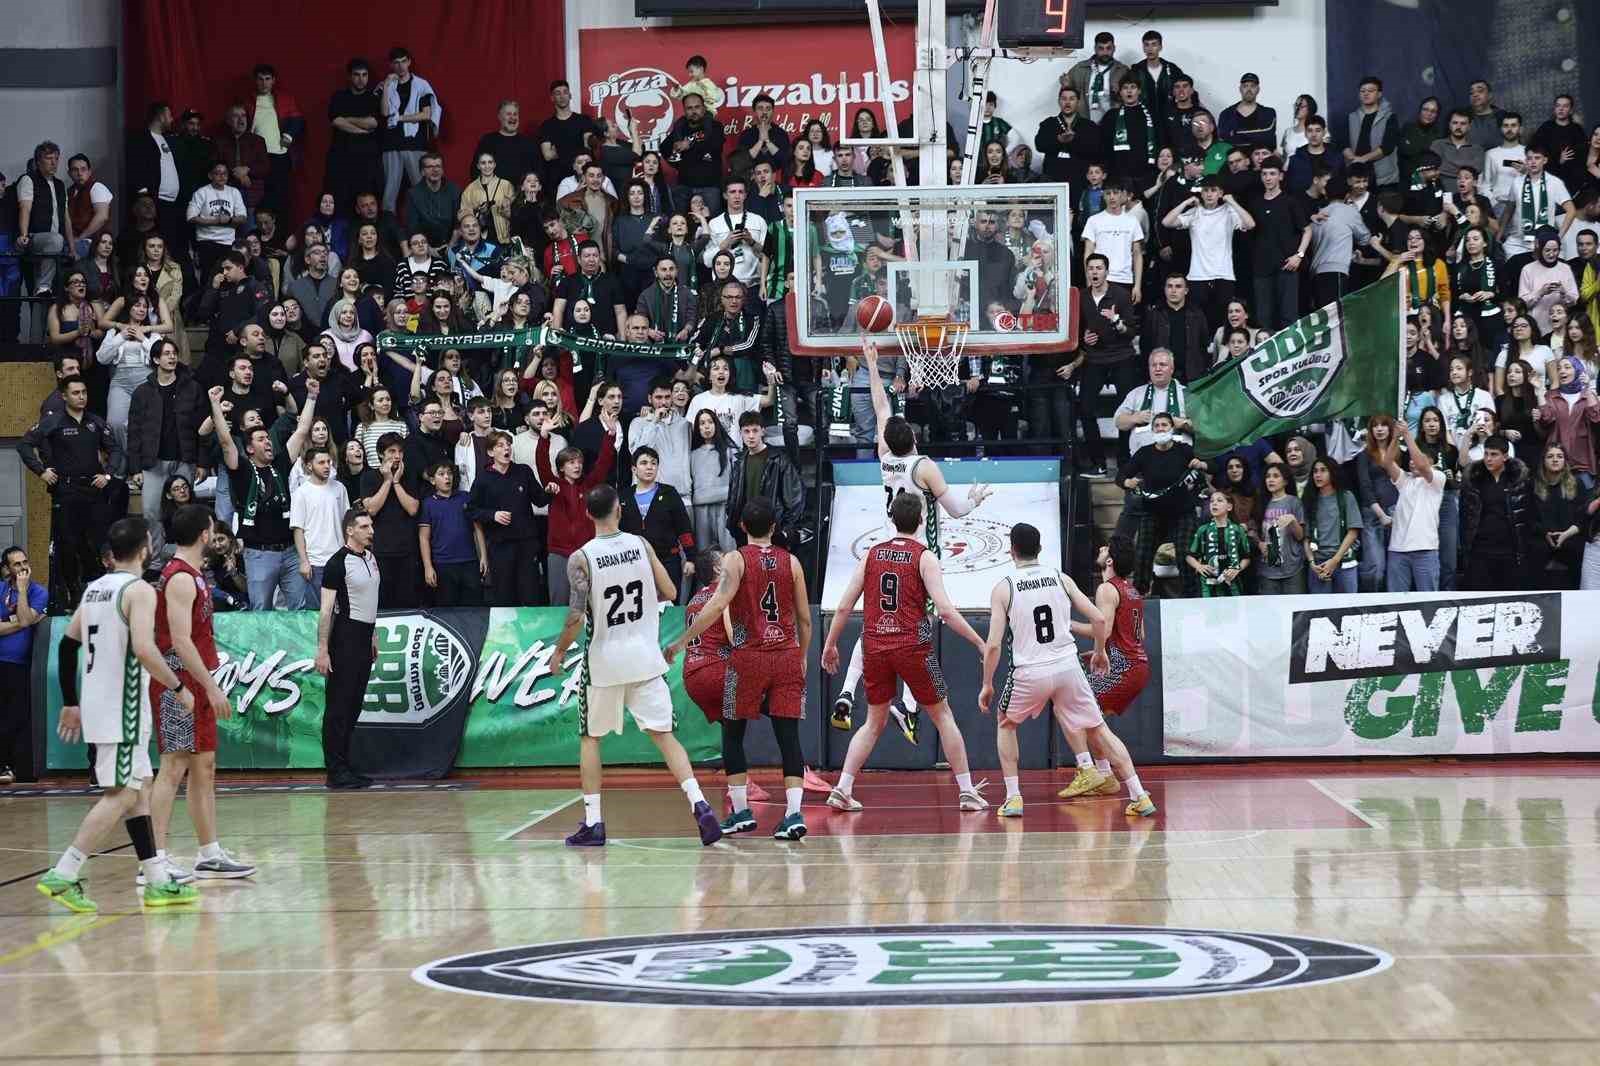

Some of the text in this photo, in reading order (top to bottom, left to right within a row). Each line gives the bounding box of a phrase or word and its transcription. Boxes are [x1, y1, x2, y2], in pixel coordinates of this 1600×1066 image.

[588, 72, 668, 107] pizza
[1258, 366, 1289, 388] SPOR
[596, 553, 620, 570] BARAN
[876, 547, 913, 564] EVREN
[603, 579, 643, 628] 23
[760, 581, 779, 623] 4
[880, 571, 899, 613] 9
[1016, 577, 1041, 592] GÖKHAN
[1032, 603, 1055, 644] 8
[1303, 600, 1544, 675] NEVER
[87, 624, 99, 675] 5
[1344, 658, 1570, 740] GIVE
